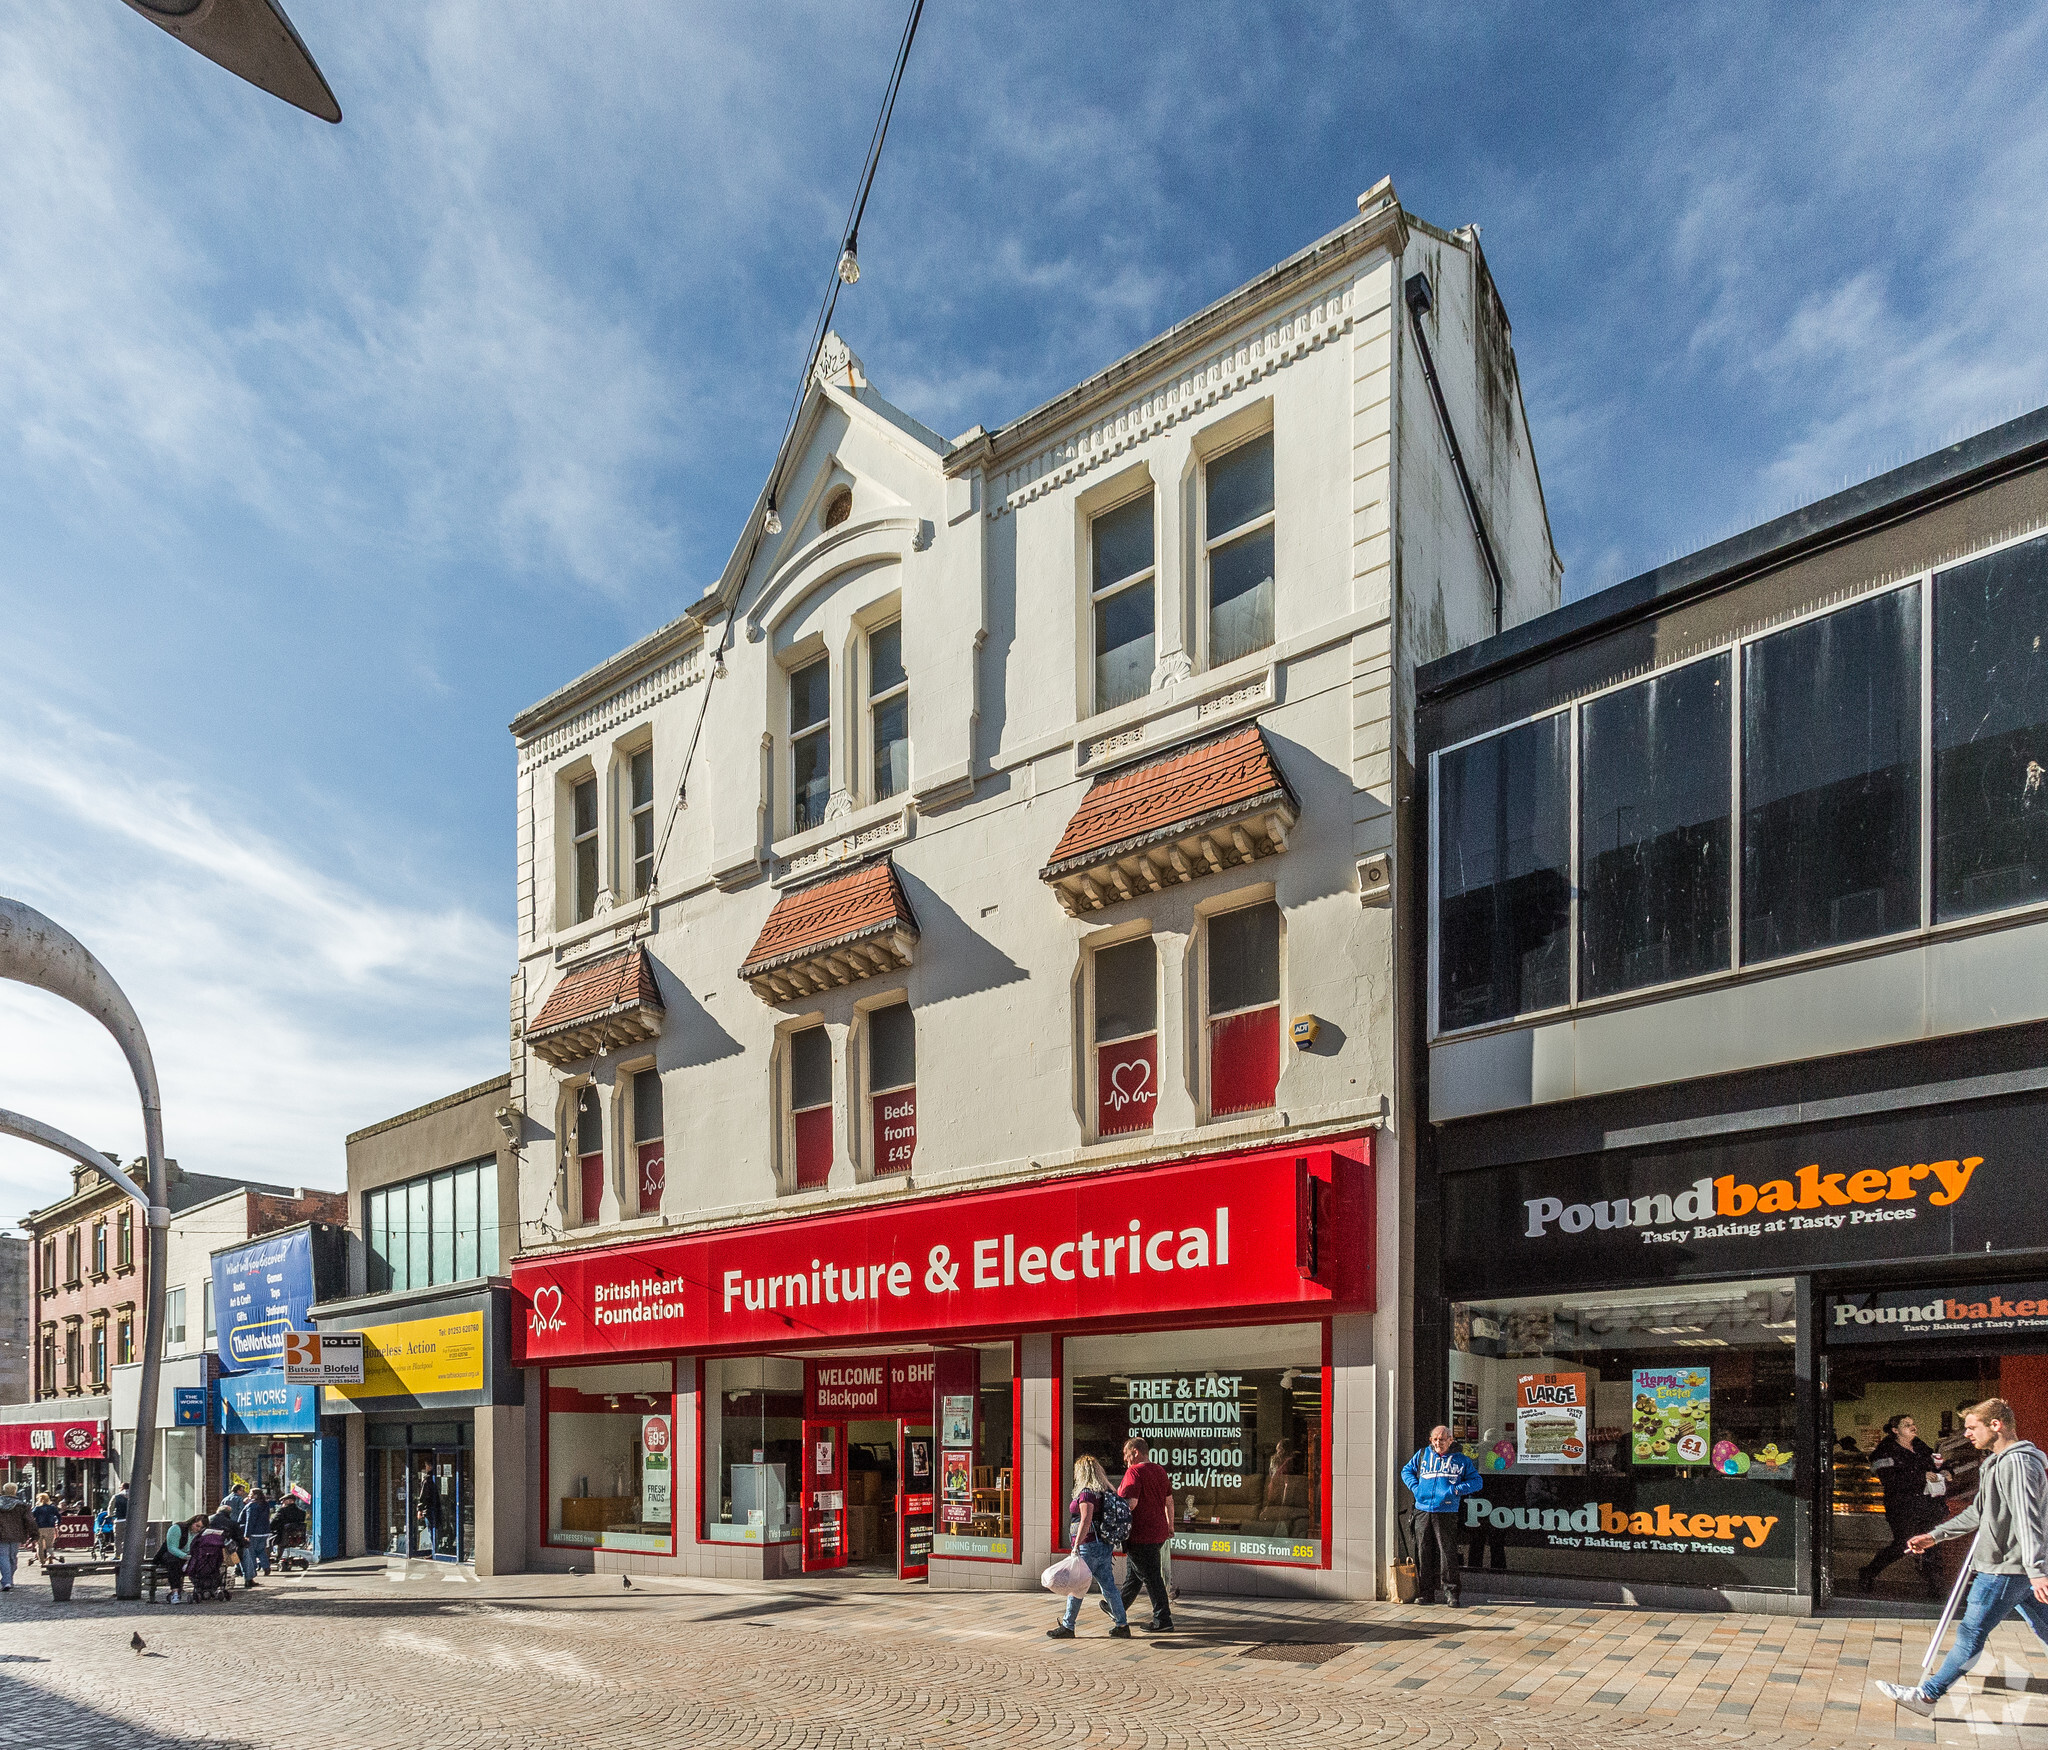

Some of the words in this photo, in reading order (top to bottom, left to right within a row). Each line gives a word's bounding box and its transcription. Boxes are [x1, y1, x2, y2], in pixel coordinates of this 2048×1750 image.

[1295, 1023, 1309, 1034] ADT
[884, 1101, 914, 1121] Beds
[884, 1126, 915, 1141] from
[888, 1145, 911, 1162] £45
[1524, 1156, 1984, 1237] Poundbakery
[1641, 1228, 1690, 1245] Tasty
[1694, 1220, 1761, 1239] Baking
[1765, 1219, 1787, 1233] at
[1789, 1212, 1845, 1231] Tasty
[1849, 1205, 1917, 1225] Prices
[226, 1262, 240, 1276] What
[260, 1245, 286, 1267] discover?
[723, 1258, 912, 1313] Furniture
[924, 1244, 960, 1294] &
[973, 1206, 1230, 1290] Electrical
[266, 1273, 282, 1284] Games
[232, 1281, 246, 1292] Books
[270, 1288, 281, 1300] Toys
[594, 1279, 640, 1302] British
[642, 1276, 684, 1297] Heart
[240, 1294, 251, 1305] Craft
[236, 1311, 247, 1322] Gifts
[594, 1299, 684, 1326] Foundation
[1902, 1324, 1932, 1332] Tasty
[1933, 1322, 1970, 1331] Baking
[1971, 1321, 1983, 1329] at
[1985, 1320, 2015, 1329] Tasty
[233, 1327, 288, 1353] TheWorks.co.
[363, 1343, 402, 1359] Homeless
[406, 1340, 437, 1355] Action
[287, 1365, 320, 1373] Butson
[323, 1364, 359, 1373] Blofeld
[818, 1368, 884, 1387] WELCOME
[891, 1368, 905, 1383] to
[907, 1363, 936, 1383] BHF
[1544, 1375, 1557, 1384] GO
[1636, 1372, 1685, 1388] Happy
[1129, 1379, 1173, 1399] FREE
[1175, 1378, 1193, 1399] &
[1195, 1376, 1243, 1398] FAST
[1524, 1384, 1578, 1406] LARGE
[1656, 1386, 1694, 1400] Easter
[235, 1391, 252, 1407] THE
[253, 1388, 287, 1406] WORKS
[818, 1388, 878, 1410] Blackpool
[1129, 1402, 1241, 1424] COLLECTION
[647, 1431, 666, 1446] £95
[1128, 1427, 1139, 1438] OF
[1139, 1427, 1163, 1438] YOUR
[1164, 1427, 1213, 1438] UNWANTED
[1213, 1427, 1242, 1438] ITEMS
[68, 1441, 91, 1450] COFFEE
[1561, 1444, 1584, 1453] £1.50
[1681, 1438, 1702, 1453] £1
[1171, 1448, 1198, 1466] 915
[1200, 1448, 1243, 1467] 3000
[647, 1484, 666, 1493] FRESH
[648, 1493, 665, 1503] FINDS
[1463, 1499, 1778, 1549] Poundbakery
[553, 1533, 583, 1543] MATTRESSES
[744, 1530, 757, 1539] £65
[945, 1541, 970, 1551] DINING
[971, 1541, 988, 1552] from
[990, 1543, 1007, 1553] £65
[1188, 1540, 1209, 1551] from
[1211, 1541, 1231, 1552] £95
[1239, 1543, 1266, 1554] BEDS
[1267, 1544, 1291, 1556] from
[1292, 1545, 1314, 1557] £65
[1547, 1535, 1582, 1547] Tasty
[1584, 1536, 1631, 1550] Baking
[1632, 1539, 1648, 1550] at
[1650, 1540, 1688, 1553] Tasty
[1690, 1541, 1735, 1554] Prices
